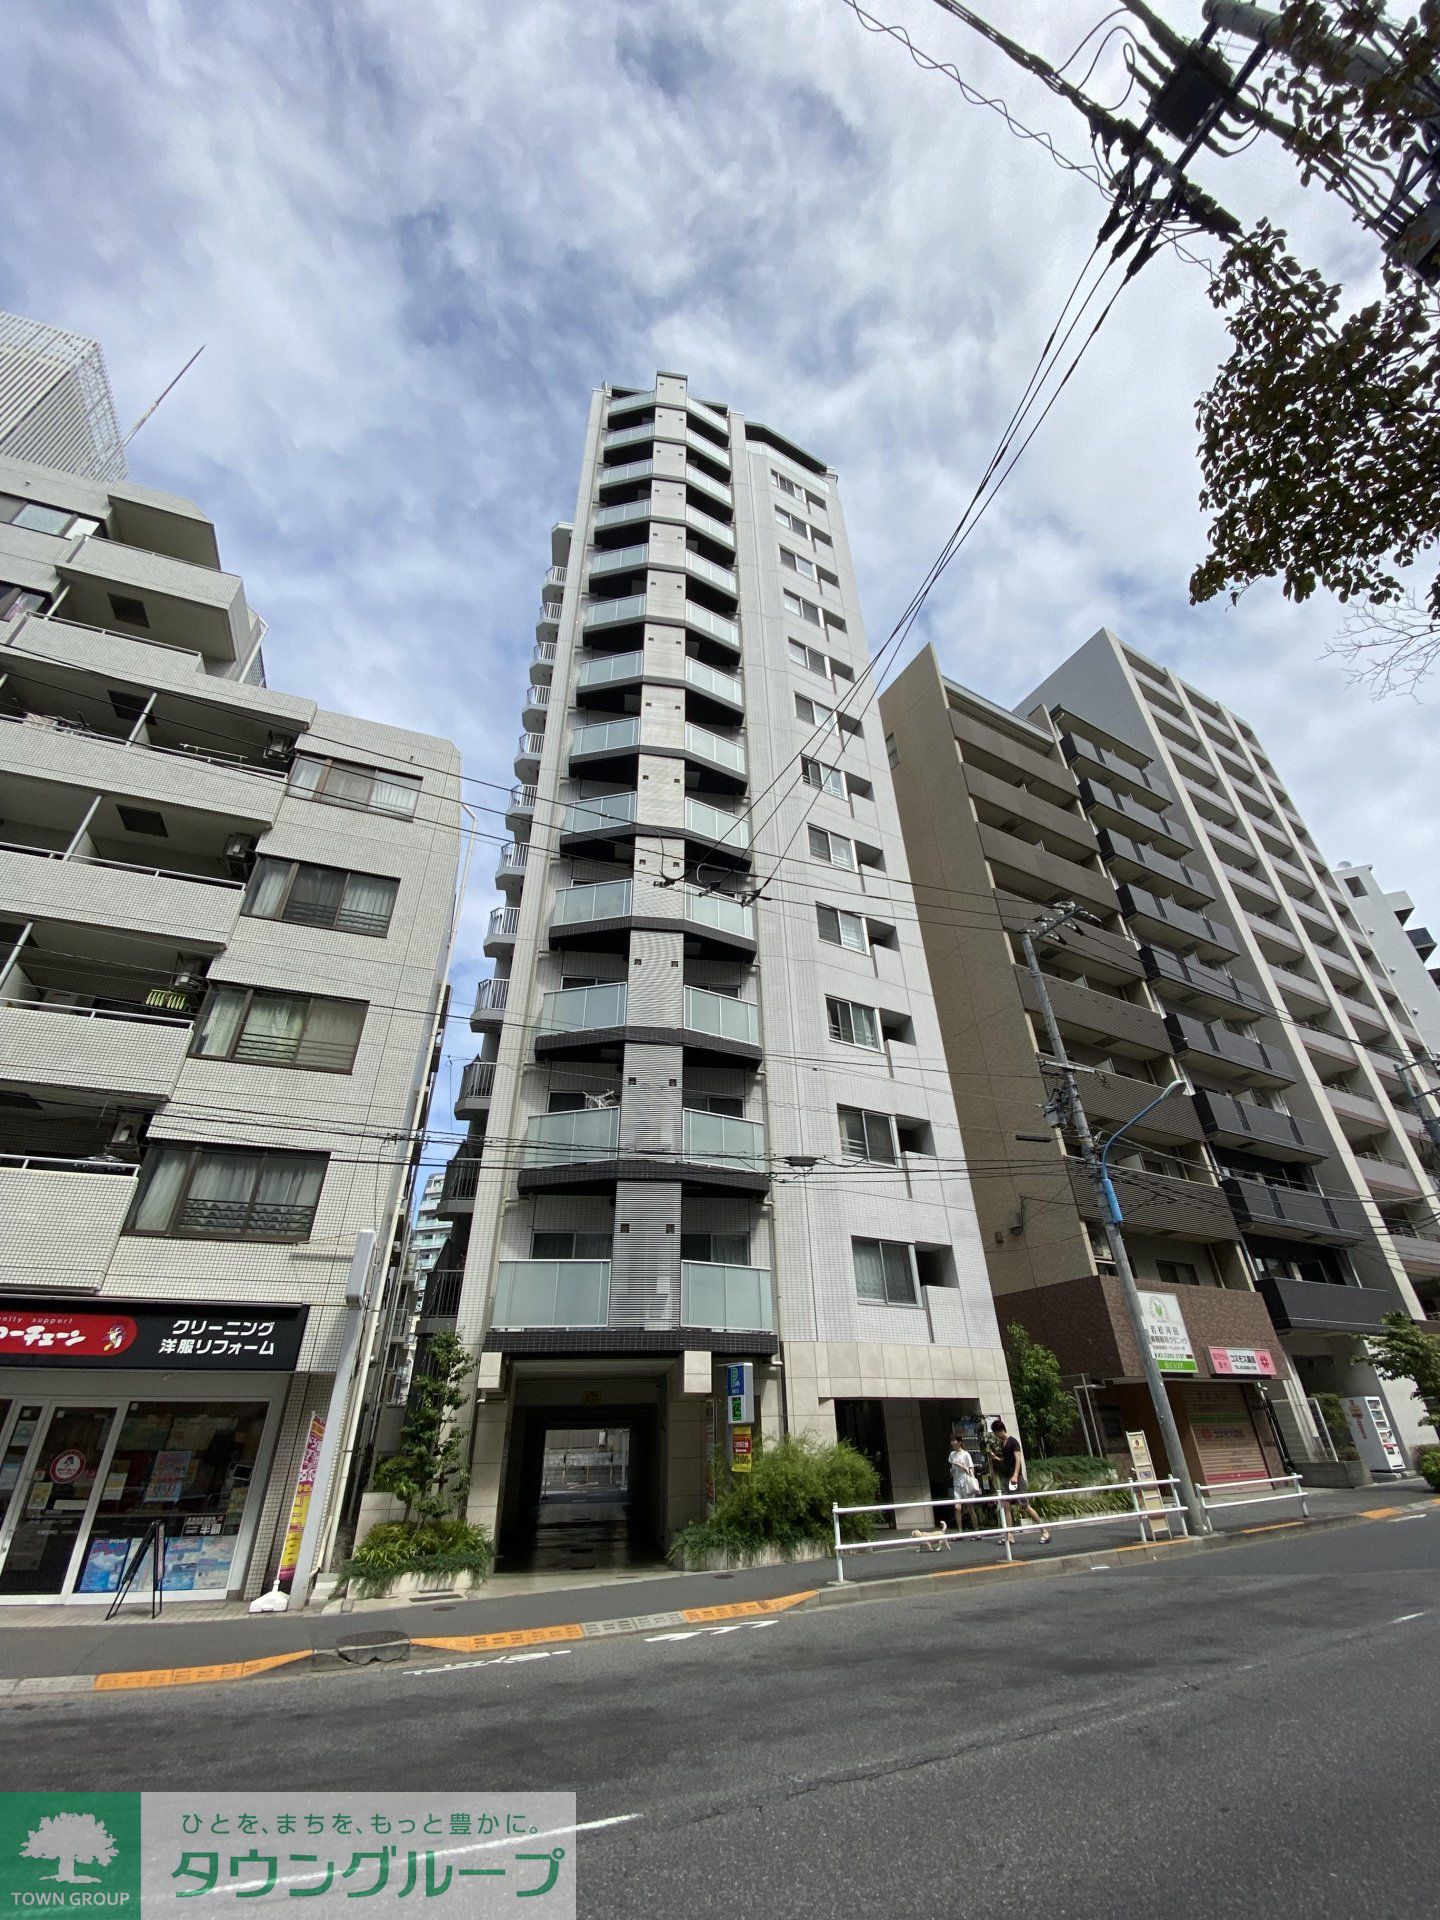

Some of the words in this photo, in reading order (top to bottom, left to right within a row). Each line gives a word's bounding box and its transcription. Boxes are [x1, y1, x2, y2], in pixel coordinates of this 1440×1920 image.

[0, 1315, 23, 1323] nity
[32, 1317, 73, 1325] support
[172, 1320, 275, 1336] クリーニング
[159, 1338, 275, 1355] 洋服リフォーム
